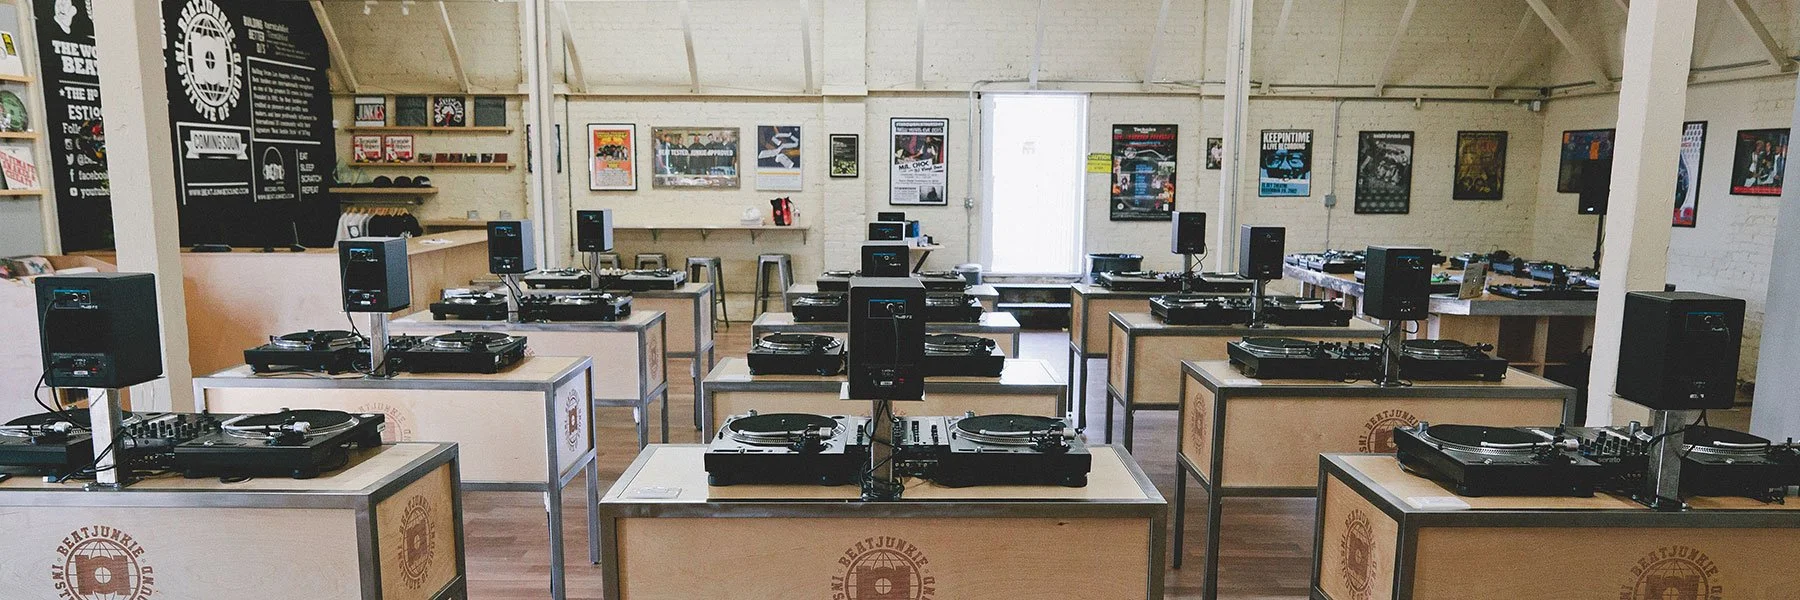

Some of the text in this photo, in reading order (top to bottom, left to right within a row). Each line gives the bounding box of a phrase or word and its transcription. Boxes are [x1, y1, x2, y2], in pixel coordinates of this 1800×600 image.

[52, 40, 80, 56] THE
[61, 55, 98, 76] BEA
[64, 86, 86, 101] THE
[193, 134, 240, 150] COMING SOON
[299, 152, 308, 160] EAT
[78, 170, 109, 181] faceboo
[300, 164, 315, 172] SLEEP
[301, 175, 322, 183] SCRATCH
[302, 186, 319, 194] REPEAT
[1365, 409, 1419, 430] BEATJUNKI
[56, 525, 145, 558] BEATJUNKIE
[838, 535, 929, 568] BEATJUNKIE
[1630, 545, 1719, 578] BEATJUNKIE
